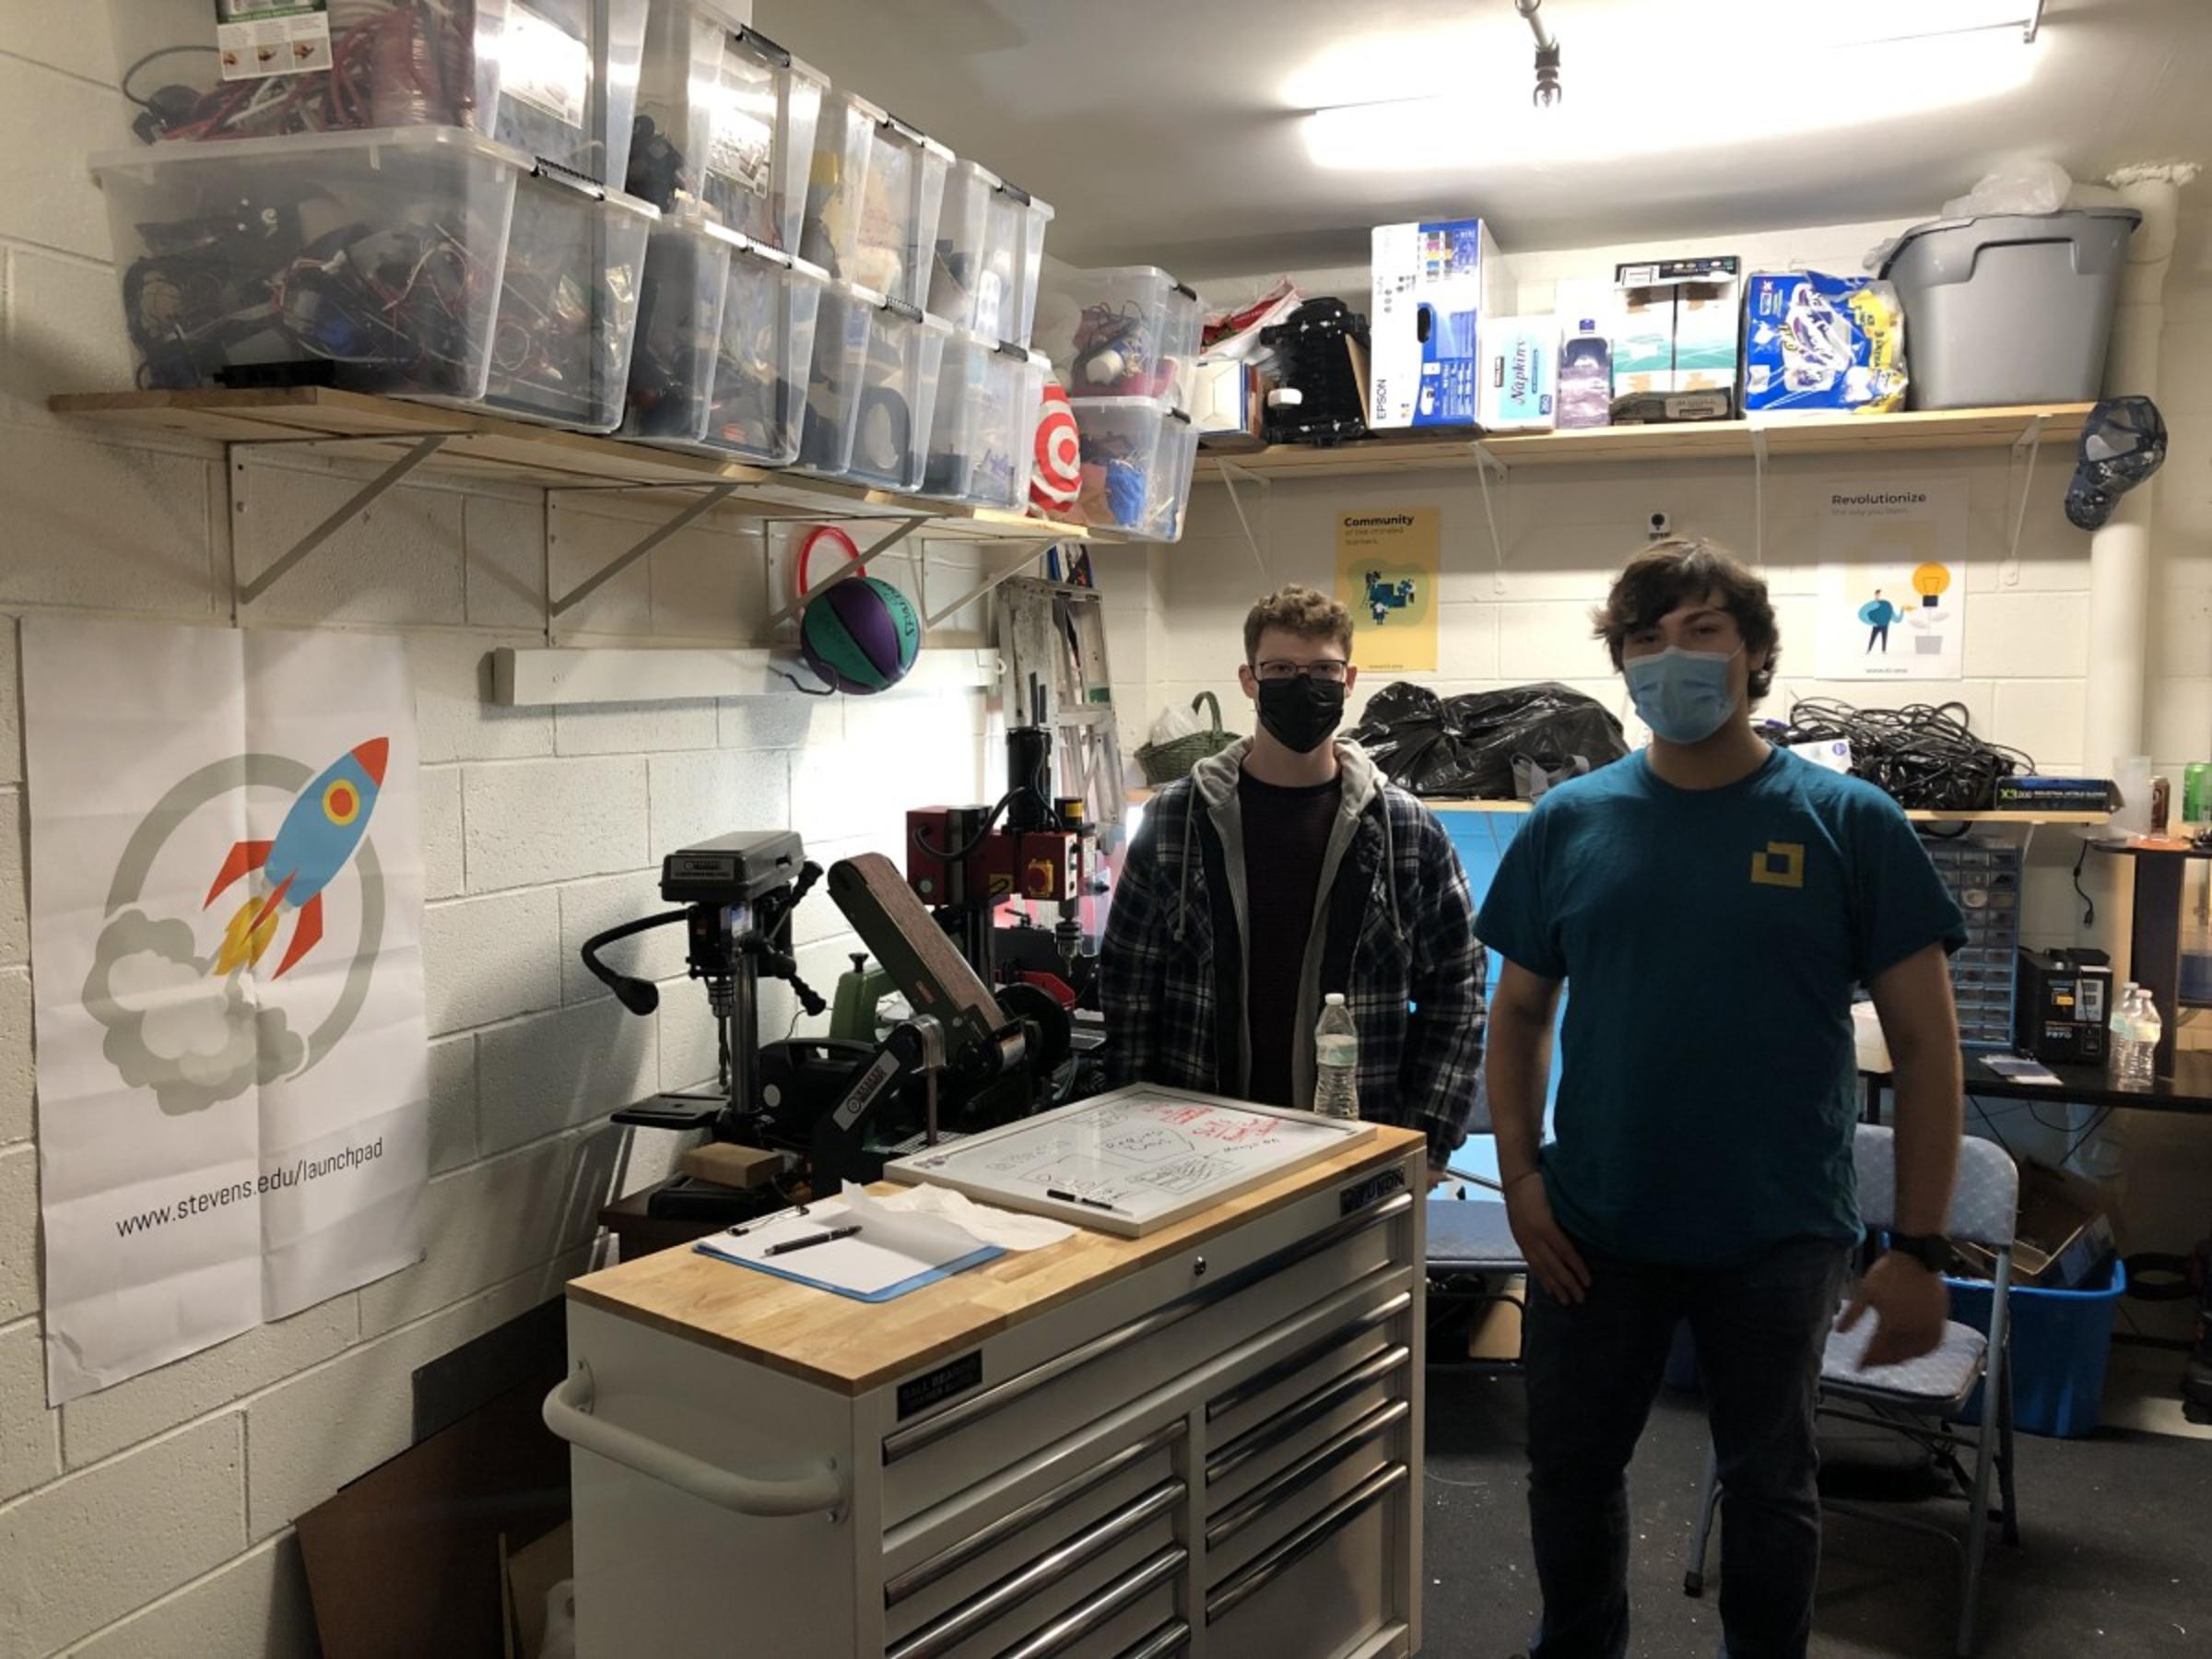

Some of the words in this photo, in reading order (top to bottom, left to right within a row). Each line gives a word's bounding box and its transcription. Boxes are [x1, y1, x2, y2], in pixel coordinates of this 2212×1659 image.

[1510, 339, 1529, 406] Napkins
[1376, 378, 1387, 420] EPSON
[1830, 491, 1928, 505] Revolutionize
[1344, 514, 1415, 527] Community
[116, 1136, 383, 1238] www.stevens.edu/launchpad
